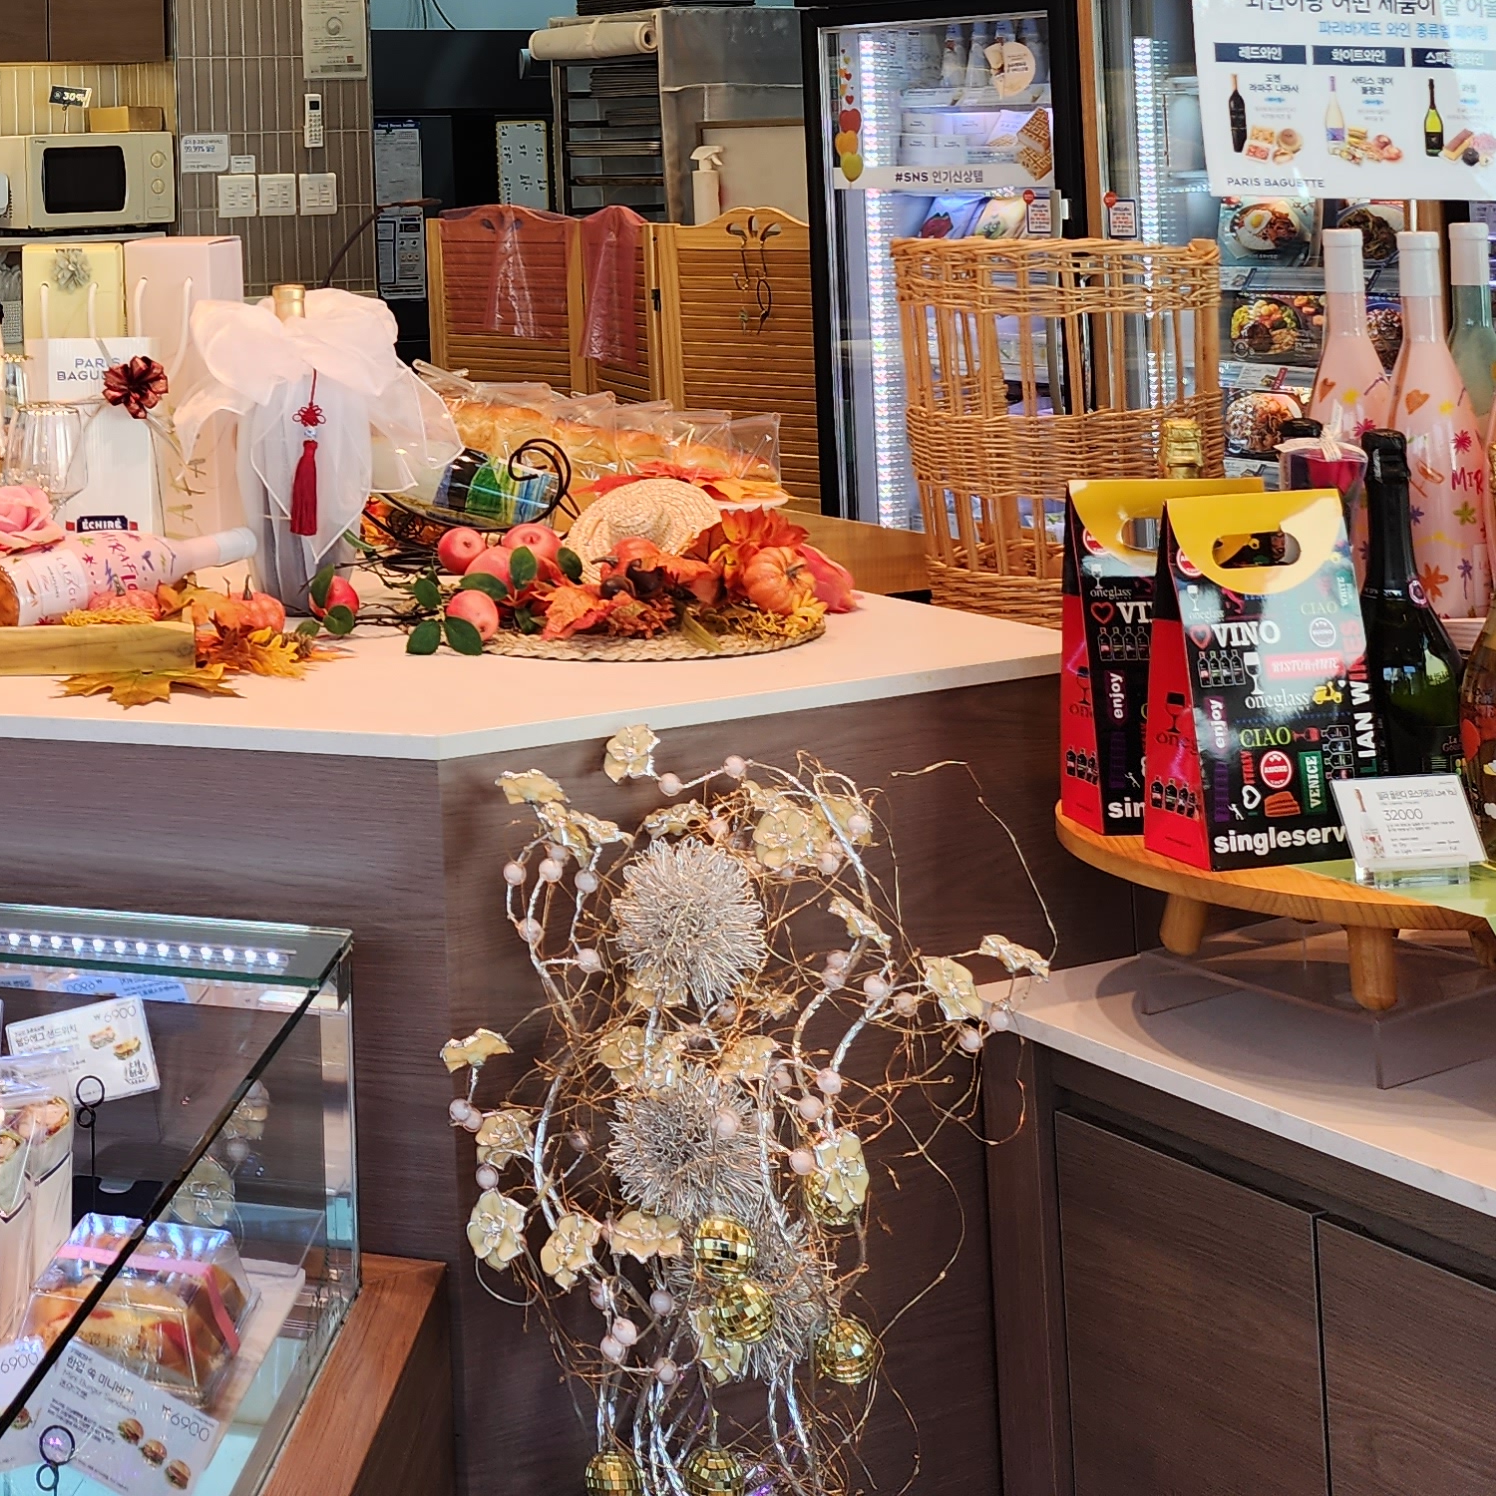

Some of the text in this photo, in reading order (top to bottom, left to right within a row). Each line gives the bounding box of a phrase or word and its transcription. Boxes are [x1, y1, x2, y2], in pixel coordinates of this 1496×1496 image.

[1318, 21, 1382, 37] 파리바게뜨
[1386, 22, 1411, 38] 와인
[1238, 46, 1283, 62] 레드와인
[1330, 48, 1387, 64] 화이트와인
[895, 169, 984, 185] #SNS 인기신상템
[1226, 177, 1326, 189] PARIS BAGUETTE
[81, 517, 123, 531] ÉCHIRÉ
[1089, 586, 1132, 600] oneglass
[1300, 601, 1339, 616] CIAO
[1212, 620, 1280, 649] VINO
[1271, 656, 1341, 674] RISTORANTE
[1110, 672, 1124, 719] enjoy
[1245, 689, 1310, 714] oneglass
[1209, 698, 1225, 749] enjoy
[1239, 726, 1292, 748] CIAO
[1305, 755, 1322, 809] VENICE
[1383, 808, 1424, 822] 32000
[65, 1355, 136, 1403] 한입 미니버거
